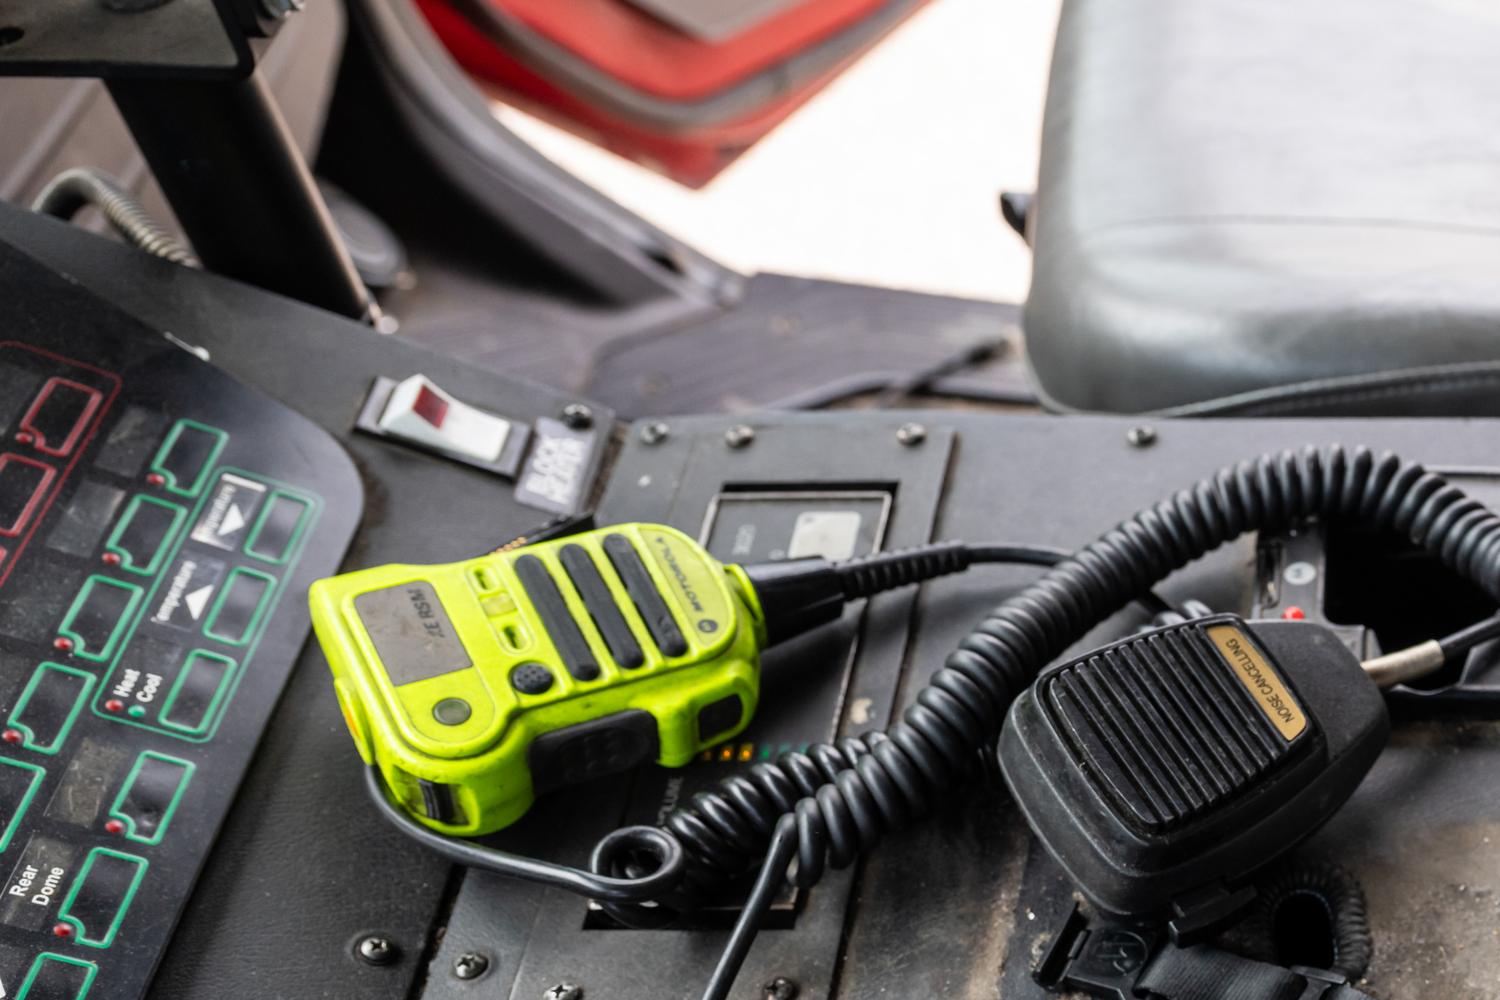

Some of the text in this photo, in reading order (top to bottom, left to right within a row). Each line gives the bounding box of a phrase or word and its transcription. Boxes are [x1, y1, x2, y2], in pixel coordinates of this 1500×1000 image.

[407, 589, 435, 619] RSM
[113, 669, 141, 698] Heat
[136, 673, 163, 703] Cool
[1225, 638, 1296, 723] NOISE CANCELLING
[9, 865, 39, 897] Rear
[31, 866, 65, 907] Dome
